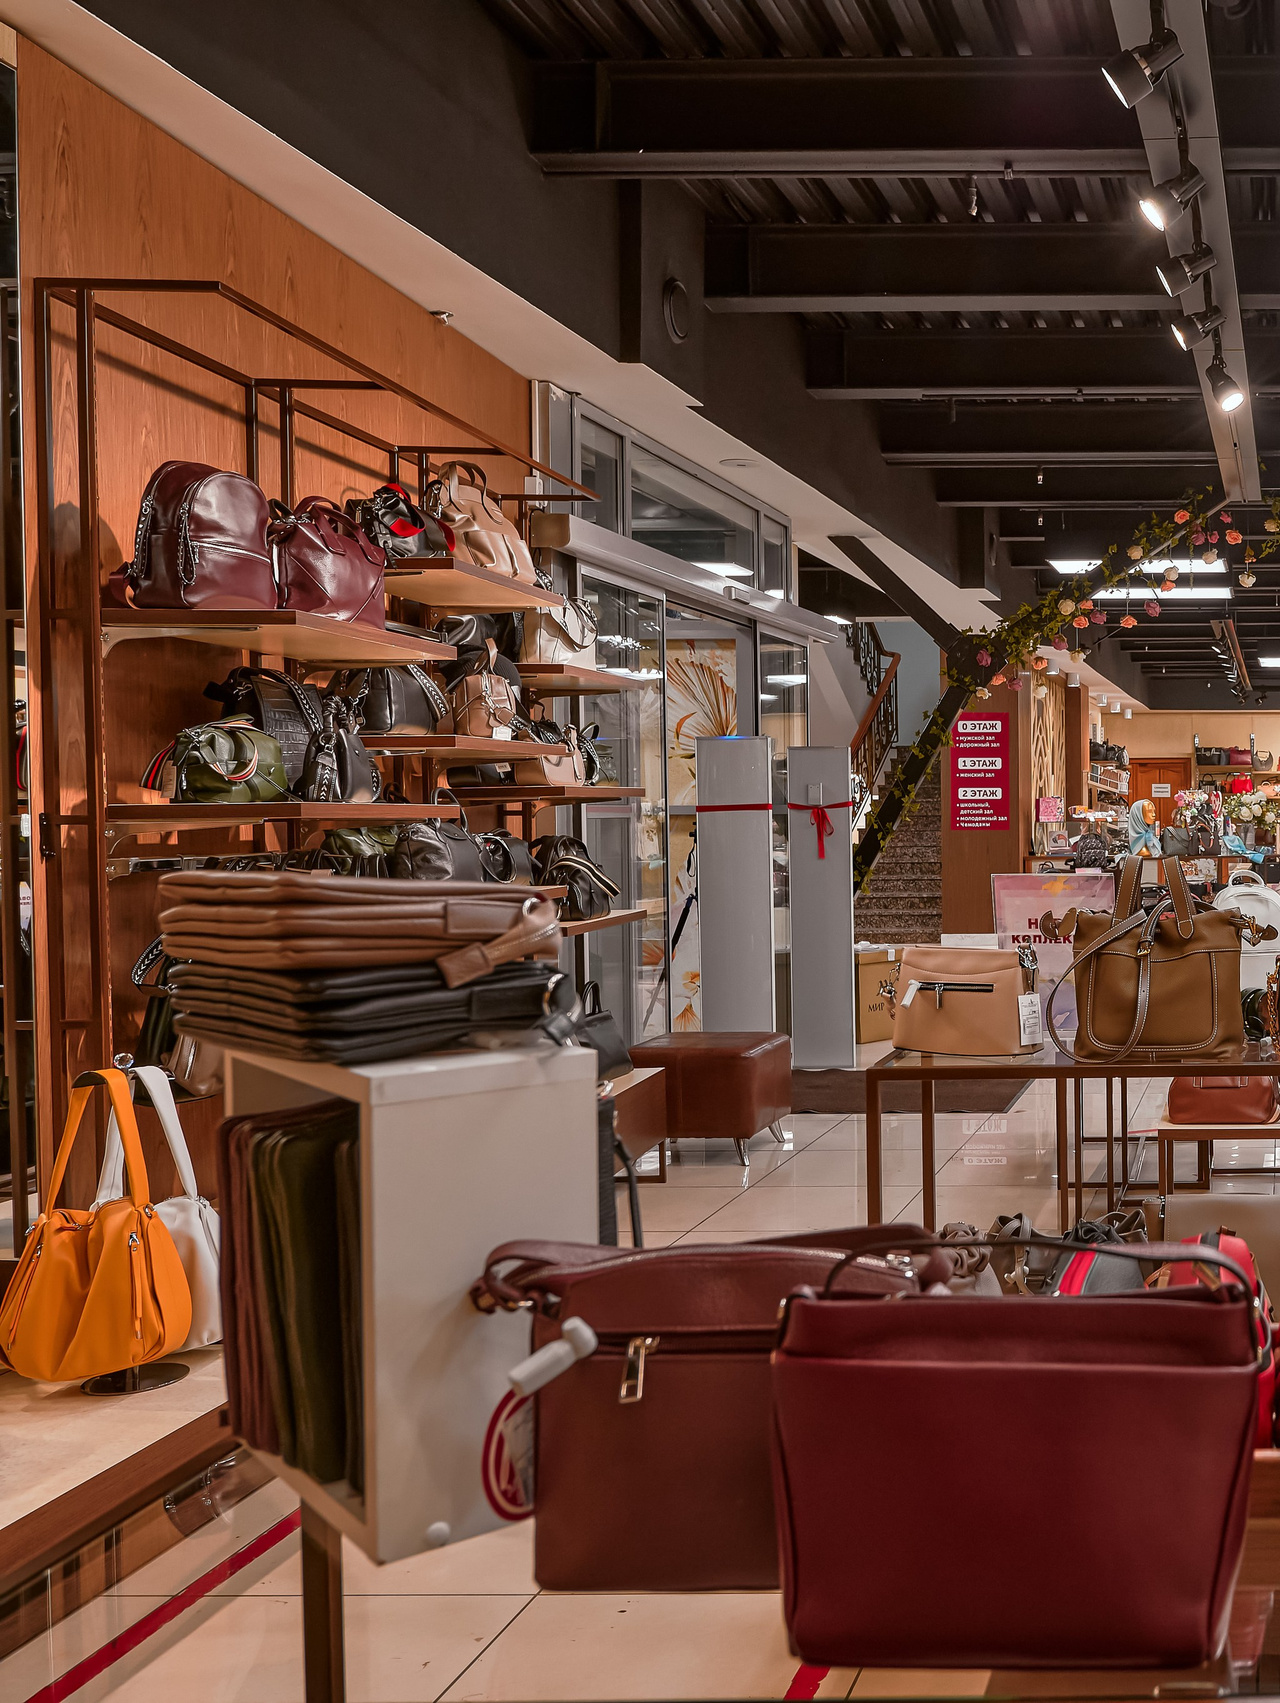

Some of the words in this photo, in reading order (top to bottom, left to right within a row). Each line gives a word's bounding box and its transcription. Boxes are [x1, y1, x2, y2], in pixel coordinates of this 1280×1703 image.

[962, 723, 968, 731] 0
[970, 723, 998, 731] ЭТАЖ
[868, 1002, 885, 1012] МИР
